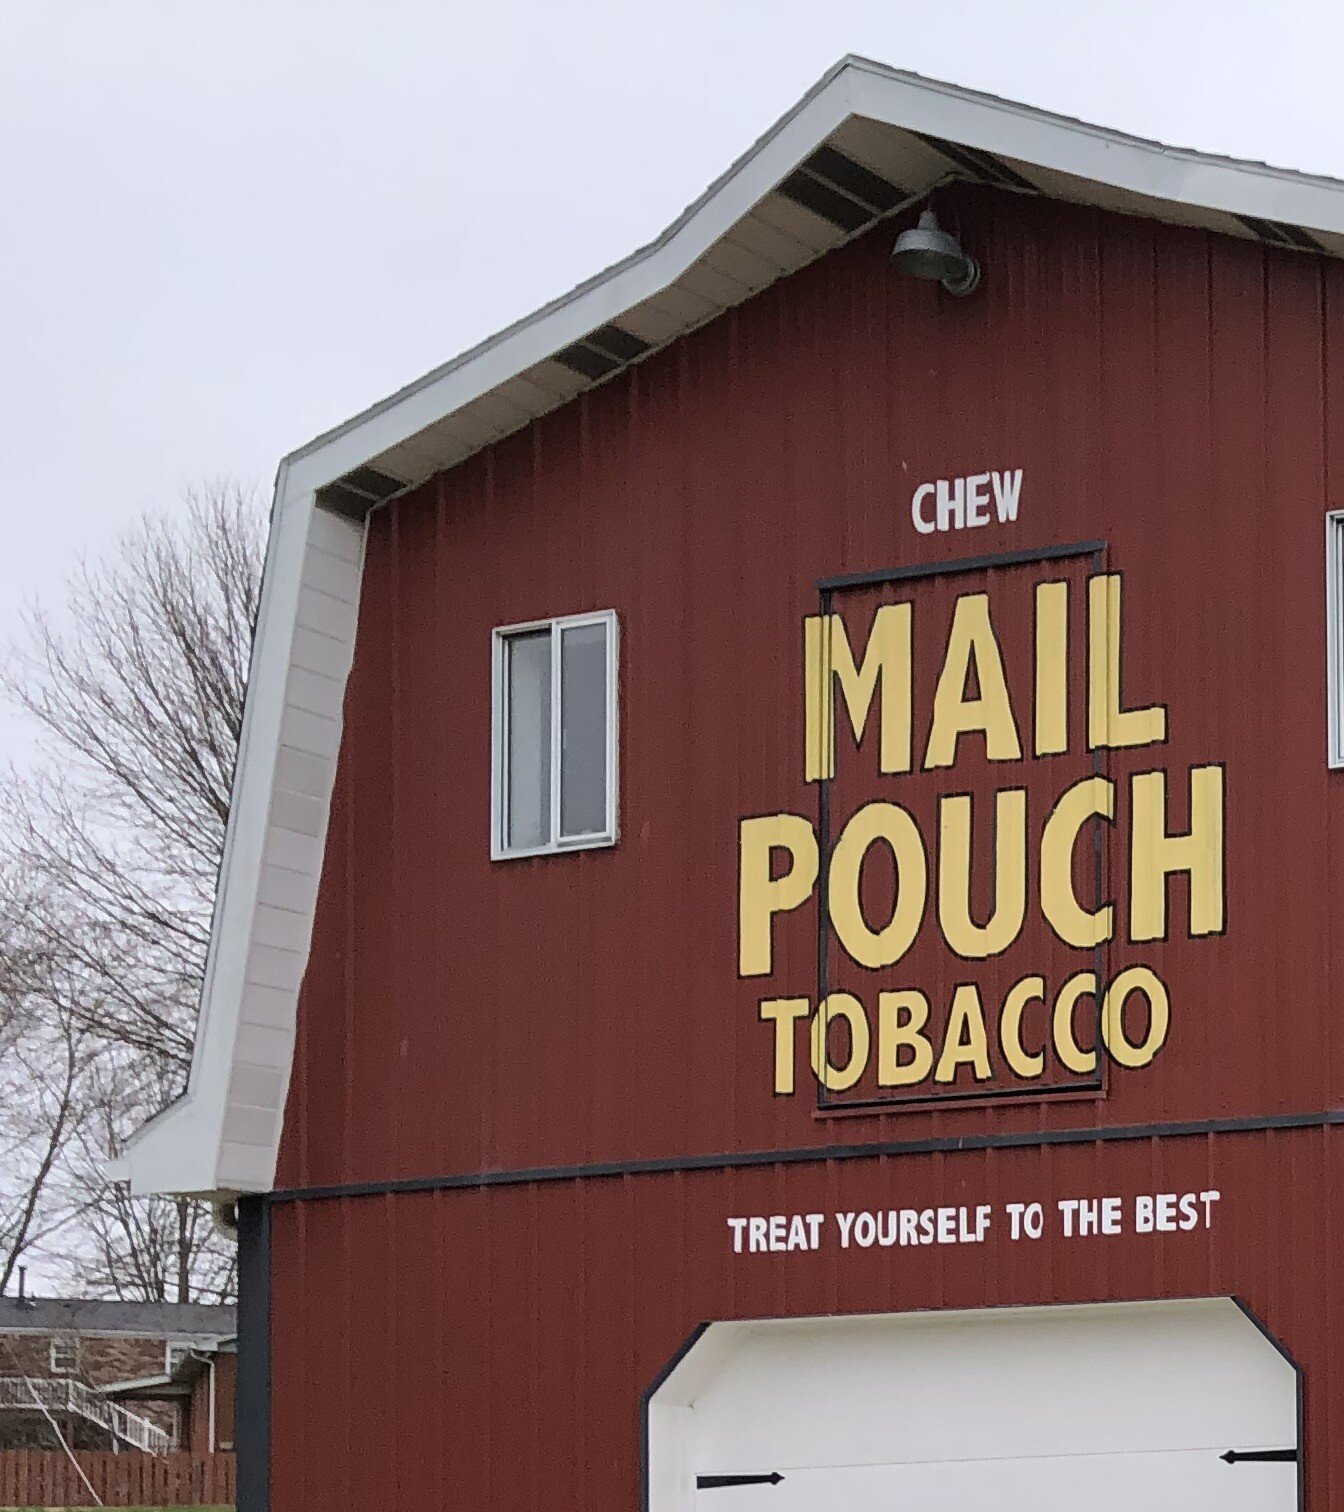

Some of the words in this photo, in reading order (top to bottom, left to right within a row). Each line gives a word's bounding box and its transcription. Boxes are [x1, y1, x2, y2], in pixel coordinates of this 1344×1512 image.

[911, 468, 1023, 534] CHEW
[804, 573, 1167, 784] MAIL
[738, 766, 1225, 978] POUCH
[760, 968, 1169, 1096] TOBACCO
[727, 1213, 825, 1254] TREAT
[835, 1205, 992, 1249] YOURSELF
[1006, 1203, 1044, 1241] TO
[1058, 1196, 1122, 1238] THE
[1135, 1190, 1221, 1234] BEST
